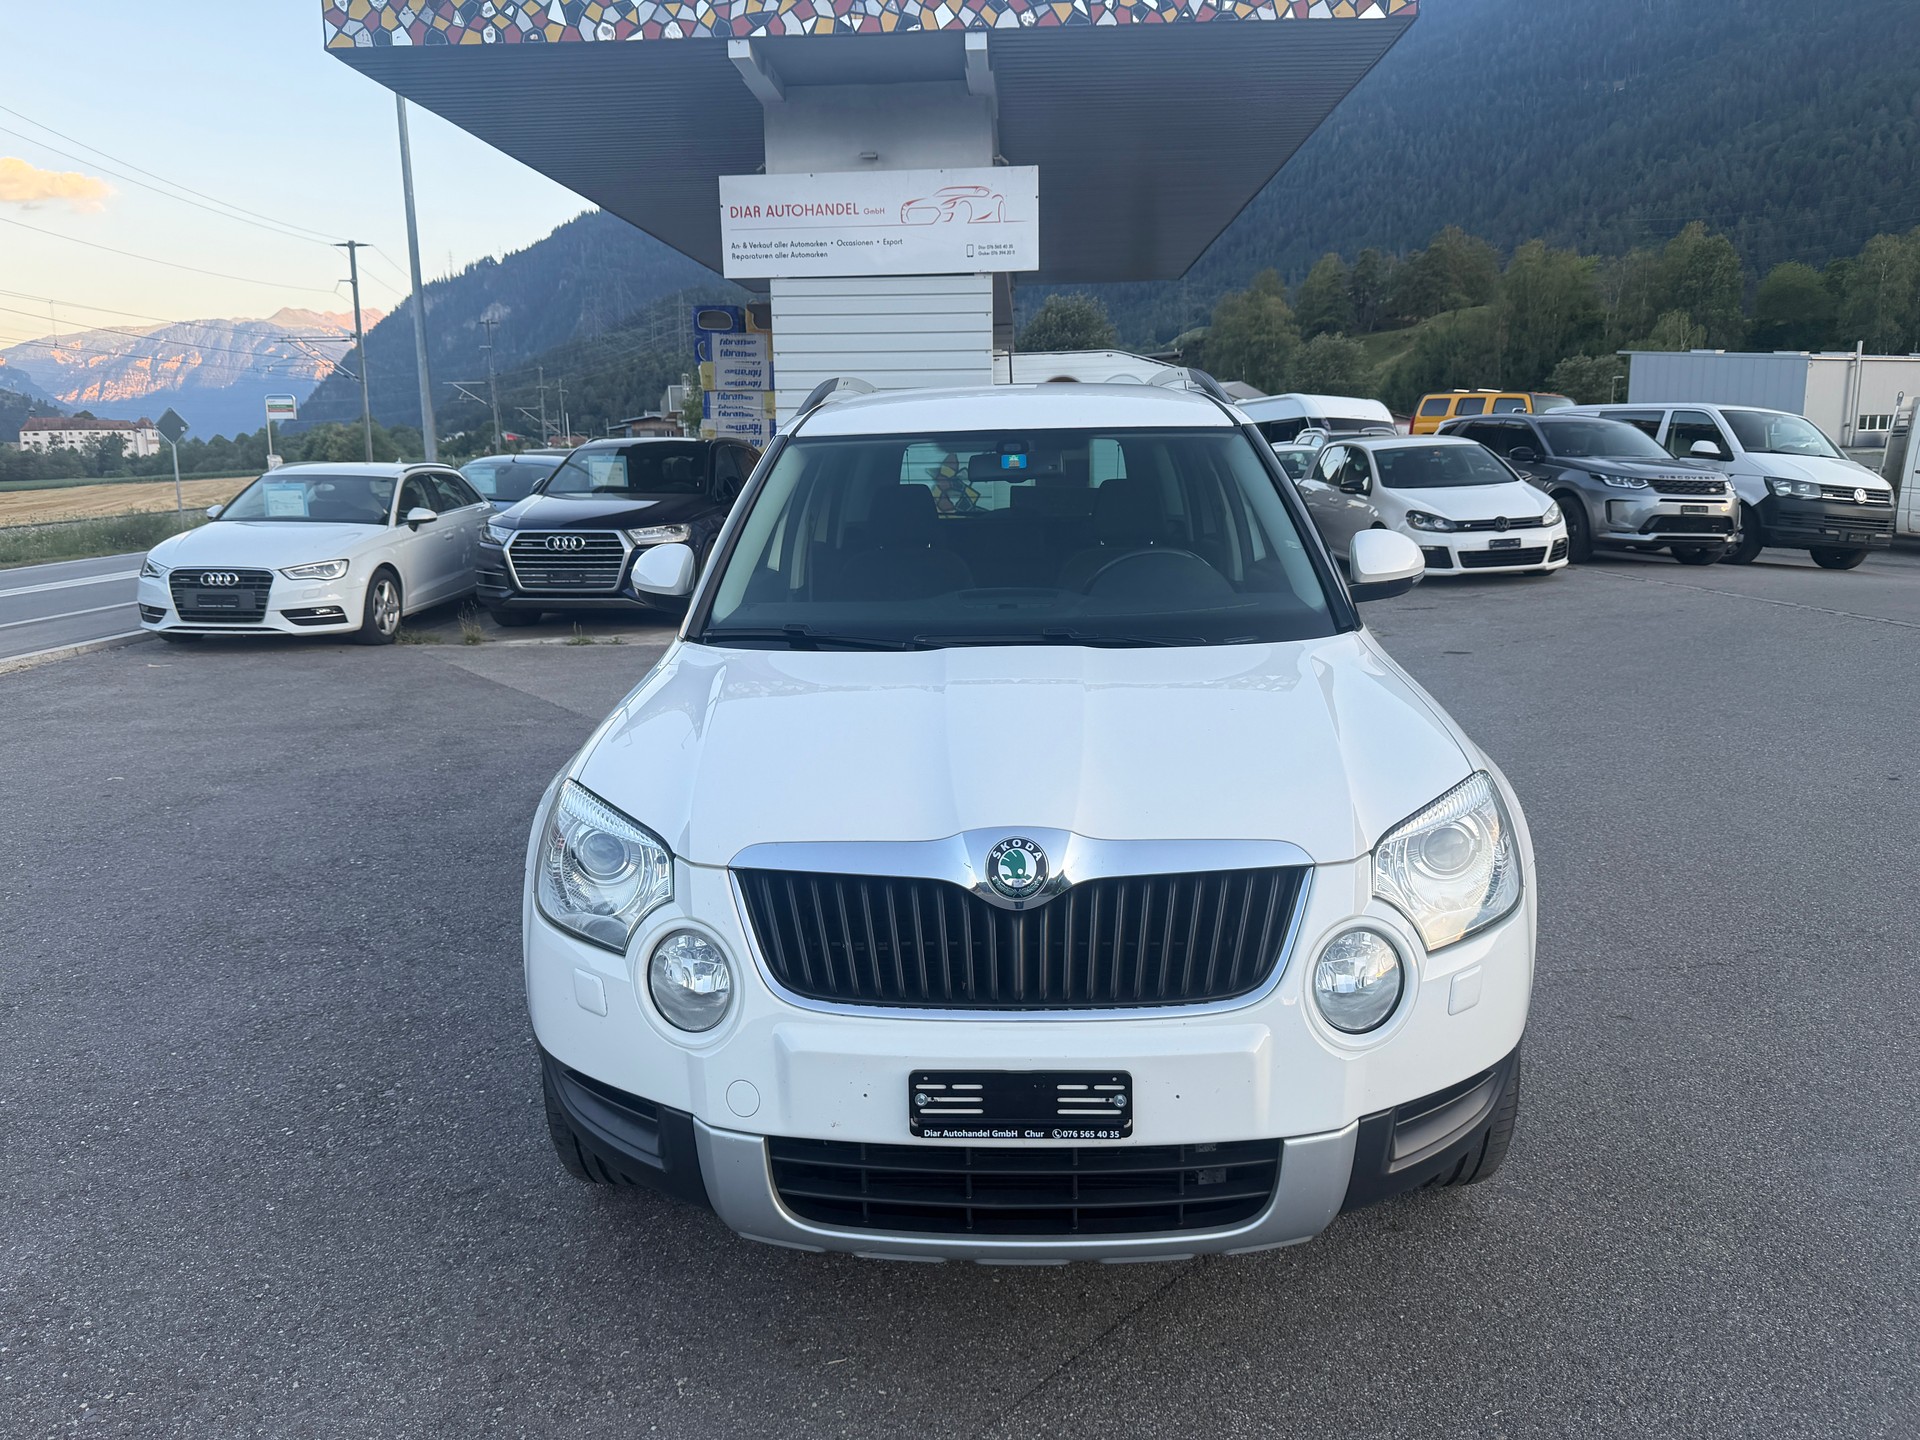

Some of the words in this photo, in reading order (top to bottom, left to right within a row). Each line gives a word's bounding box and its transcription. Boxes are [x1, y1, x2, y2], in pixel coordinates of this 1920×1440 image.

[730, 205, 761, 218] DIAR
[766, 202, 859, 218] AUTOHANDEL
[883, 238, 903, 246] Export
[732, 253, 773, 261] Reparaturen
[924, 1129, 941, 1138] Diar
[943, 1129, 990, 1138] Autohandel
[992, 1129, 1018, 1138] GmbH
[1025, 1130, 1044, 1138] Chur
[1062, 1130, 1078, 1138] 076
[1080, 1130, 1095, 1138] 565
[1097, 1130, 1107, 1138] 40
[1110, 1130, 1120, 1138] 35
